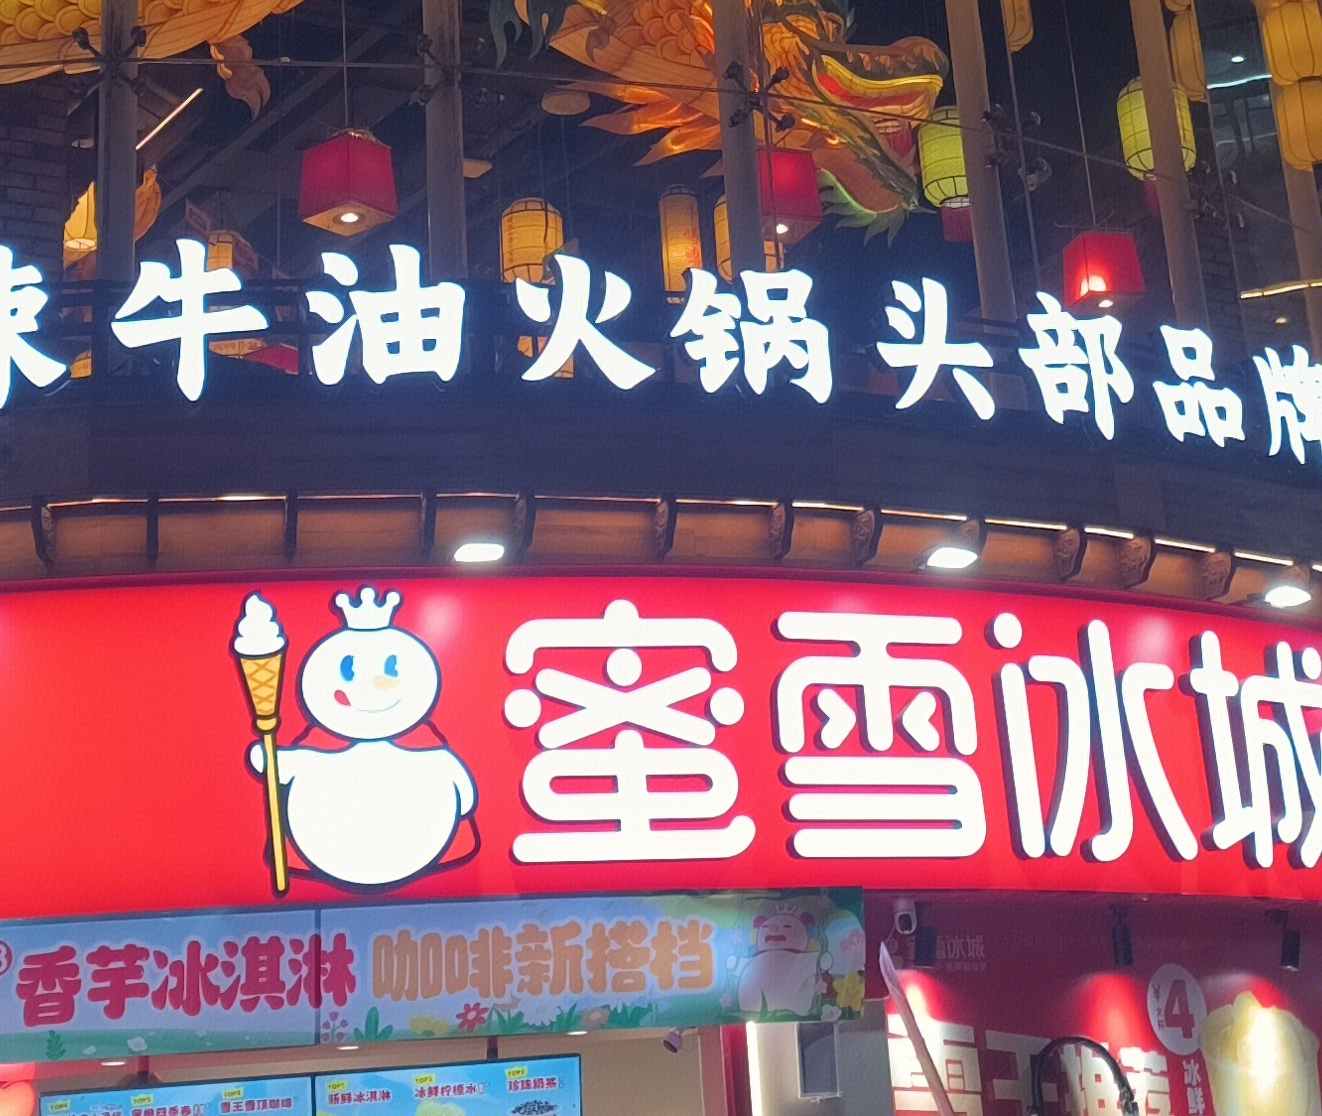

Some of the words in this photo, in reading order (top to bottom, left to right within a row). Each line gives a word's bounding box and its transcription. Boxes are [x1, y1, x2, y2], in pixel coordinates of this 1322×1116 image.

[14, 931, 358, 1029] 香芋冰淇淋
[371, 918, 717, 1004] 咖啡新搭档
